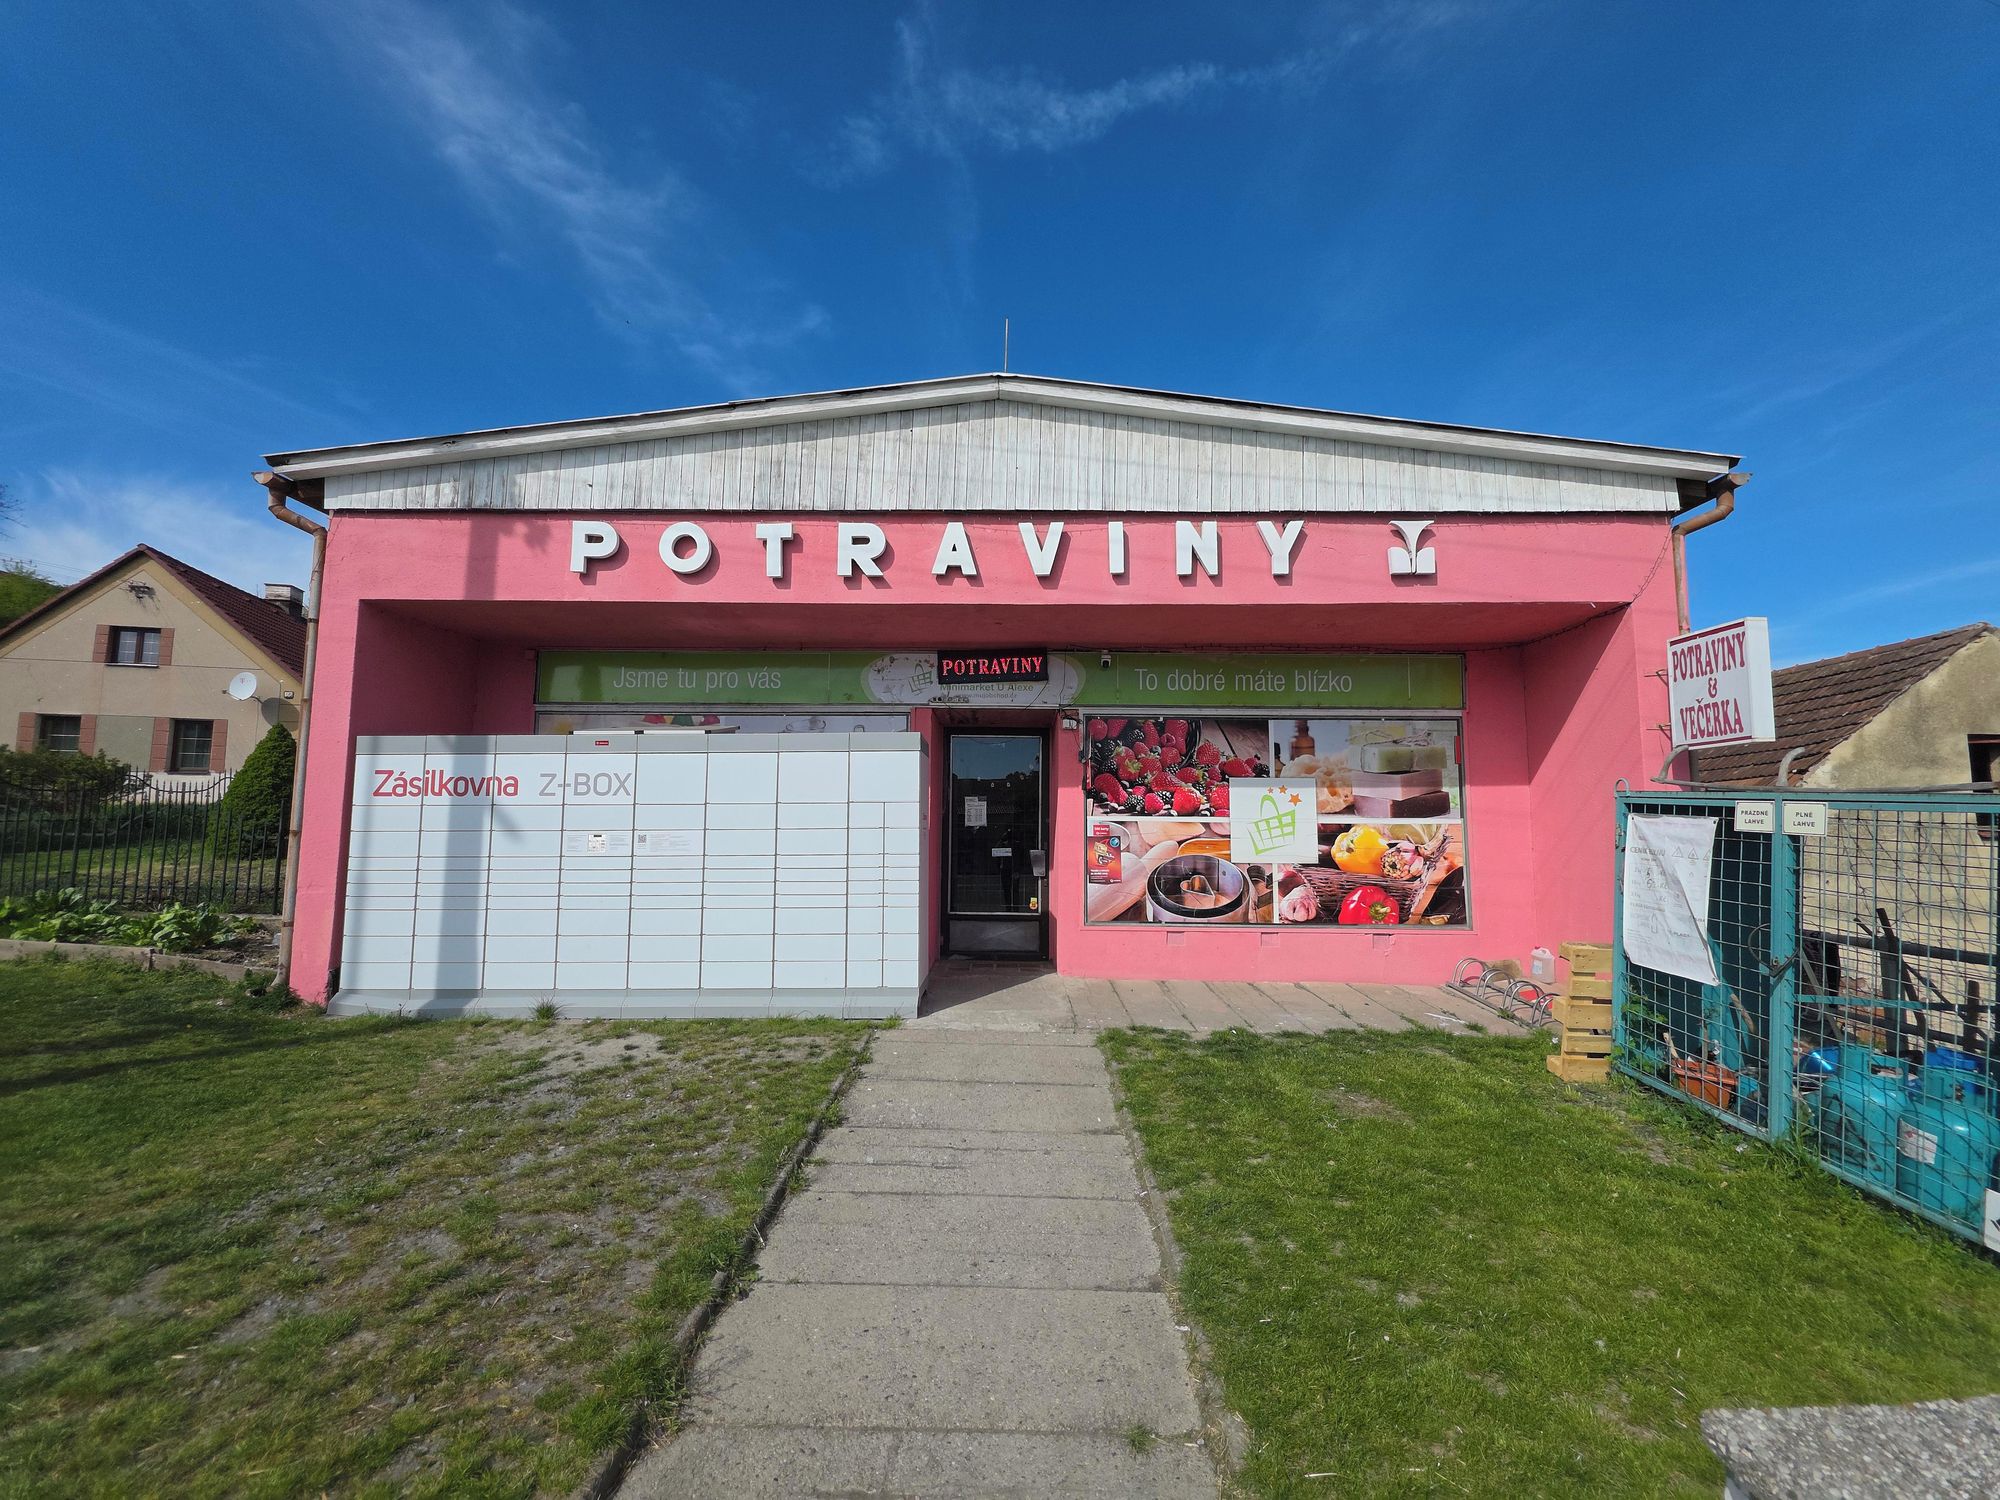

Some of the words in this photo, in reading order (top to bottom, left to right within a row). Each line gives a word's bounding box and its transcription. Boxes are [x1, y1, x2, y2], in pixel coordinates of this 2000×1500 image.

[570, 520, 1305, 579] POTRAVINY
[942, 656, 1043, 676] POTRAVINY
[1672, 631, 1745, 682] POTRAVINY
[613, 666, 668, 688] Jsme
[678, 668, 696, 688] tu
[706, 670, 738, 693] pro
[747, 666, 781, 688] vás
[1134, 669, 1158, 691] To
[1167, 669, 1225, 691] dobré
[1234, 669, 1286, 692] máte
[1294, 669, 1353, 693] blízko
[1708, 677, 1718, 698] &
[1680, 698, 1744, 740] VEČERKA
[372, 769, 519, 798] Zásilkovna
[538, 772, 633, 797] Z-BOX
